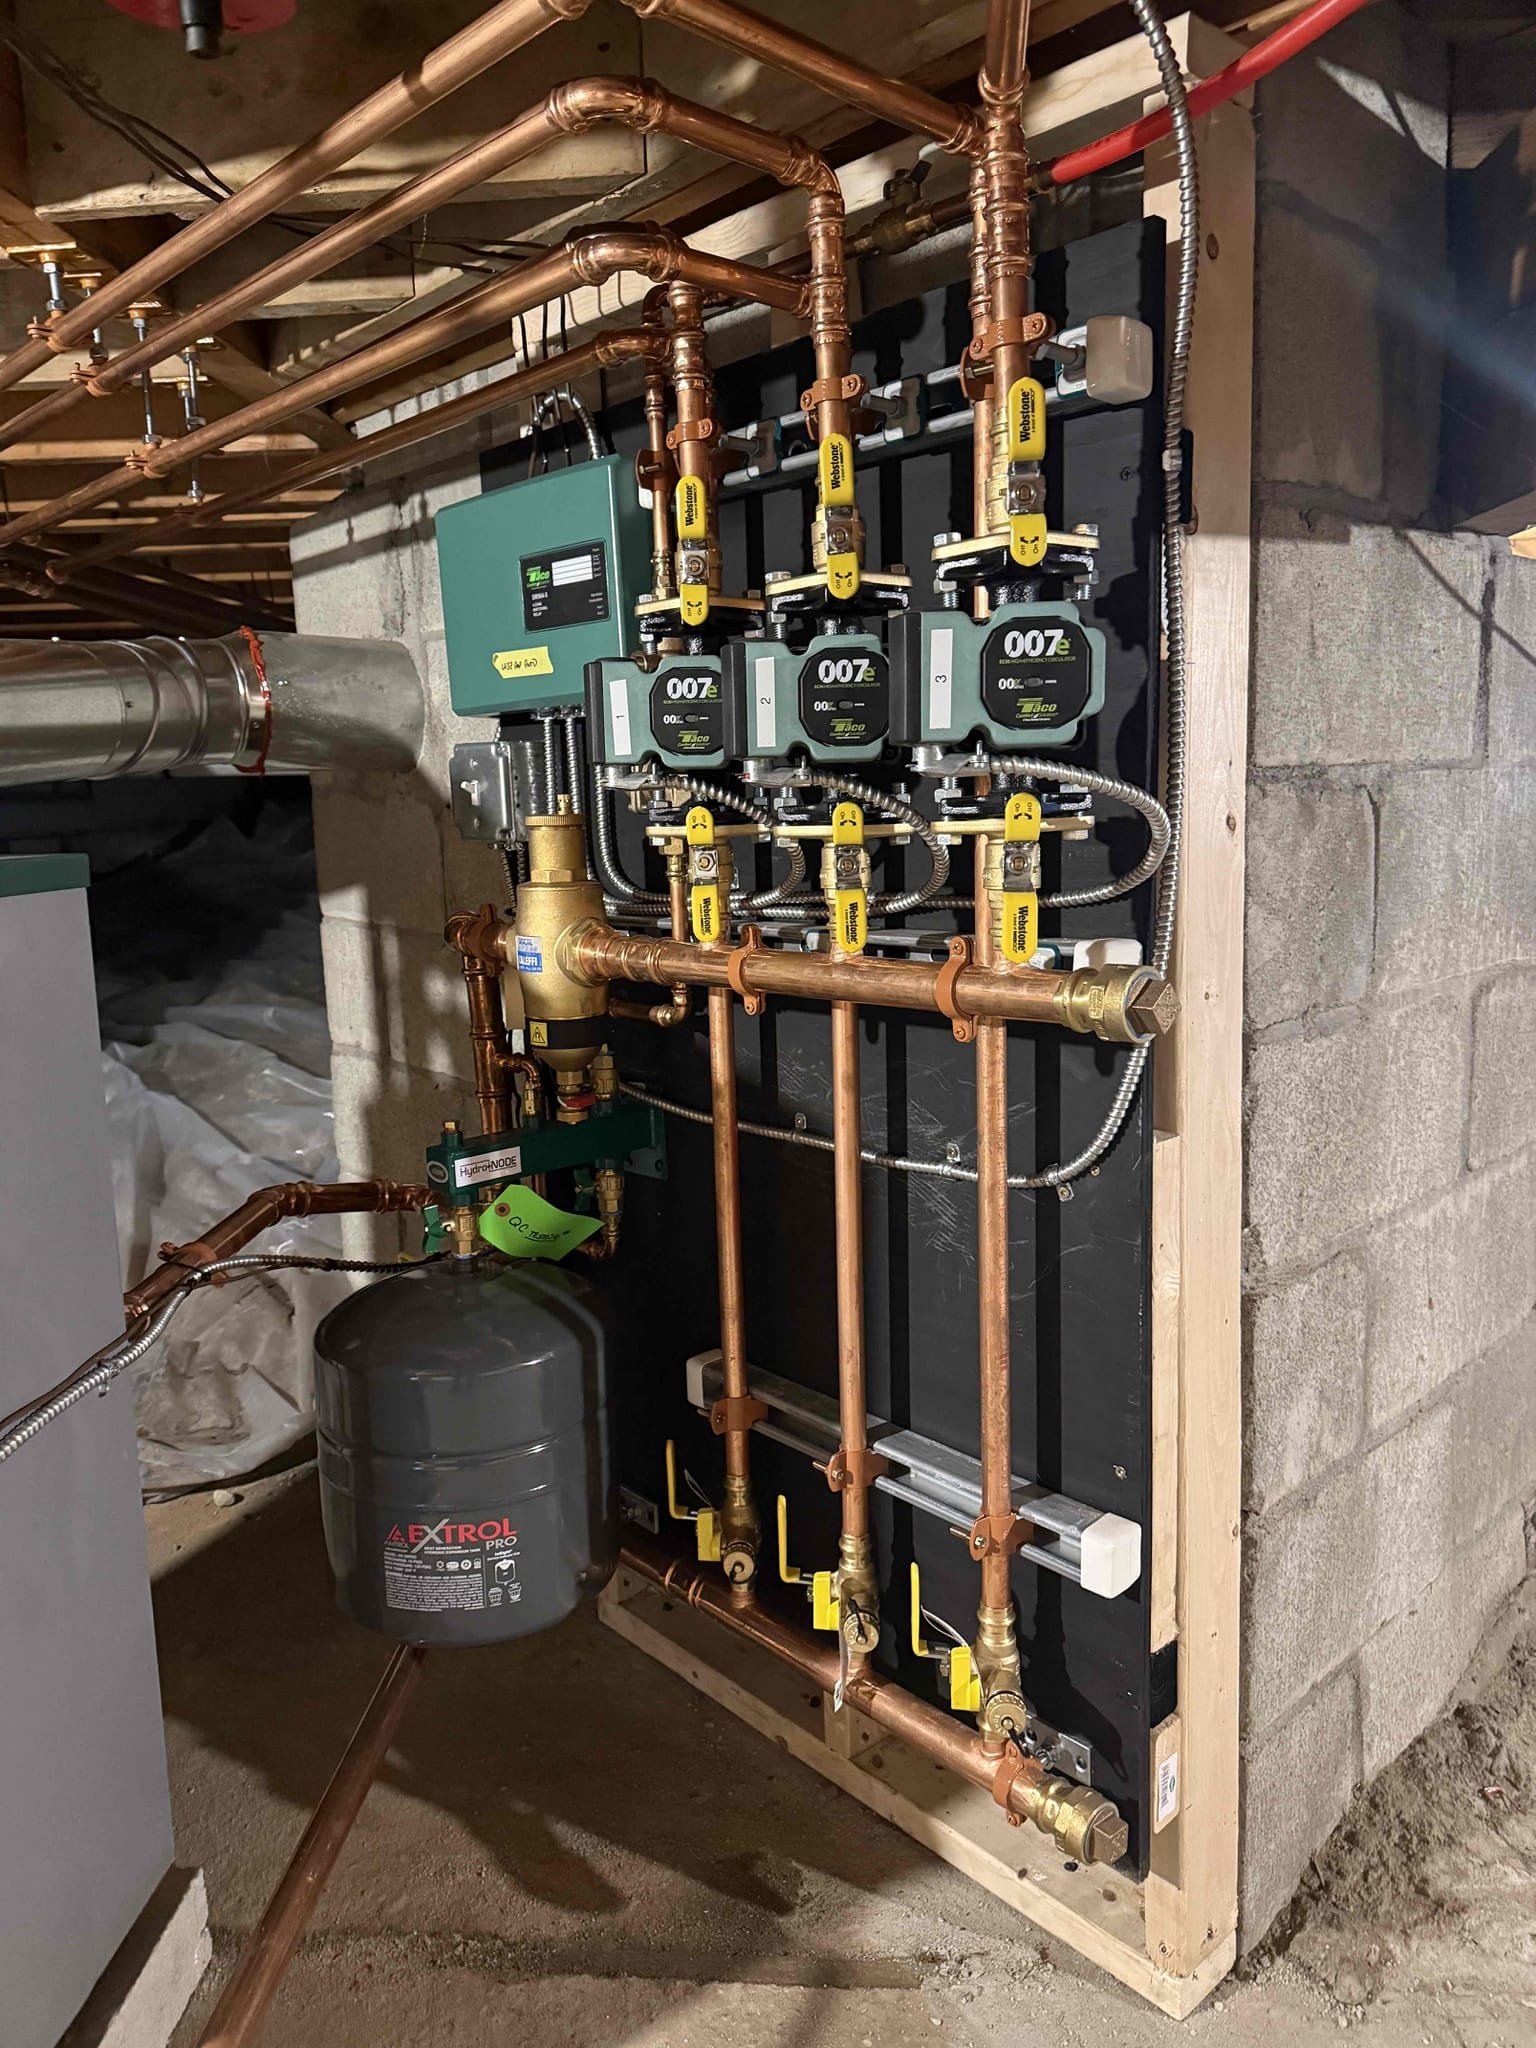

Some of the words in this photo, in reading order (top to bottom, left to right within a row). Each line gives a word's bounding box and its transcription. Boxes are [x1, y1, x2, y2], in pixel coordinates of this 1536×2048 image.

[1020, 390, 1030, 443] Webstone
[832, 443, 841, 490] Webstone
[685, 484, 694, 526] Webstone
[526, 566, 550, 582] Taco
[1004, 629, 1070, 658] 007e
[818, 659, 875, 684] 007e
[935, 674, 947, 683] 3
[667, 677, 719, 700] 007e
[760, 697, 771, 705] 2
[1016, 698, 1056, 713] Taco
[677, 730, 710, 743] Taco
[830, 718, 865, 732] Taco
[703, 897, 711, 933] Webstone
[849, 902, 858, 943] Webstone
[1018, 906, 1028, 952] Webstone
[508, 1216, 528, 1233] QC
[408, 1518, 517, 1553] EXTROL
[486, 1536, 517, 1550] PRO
